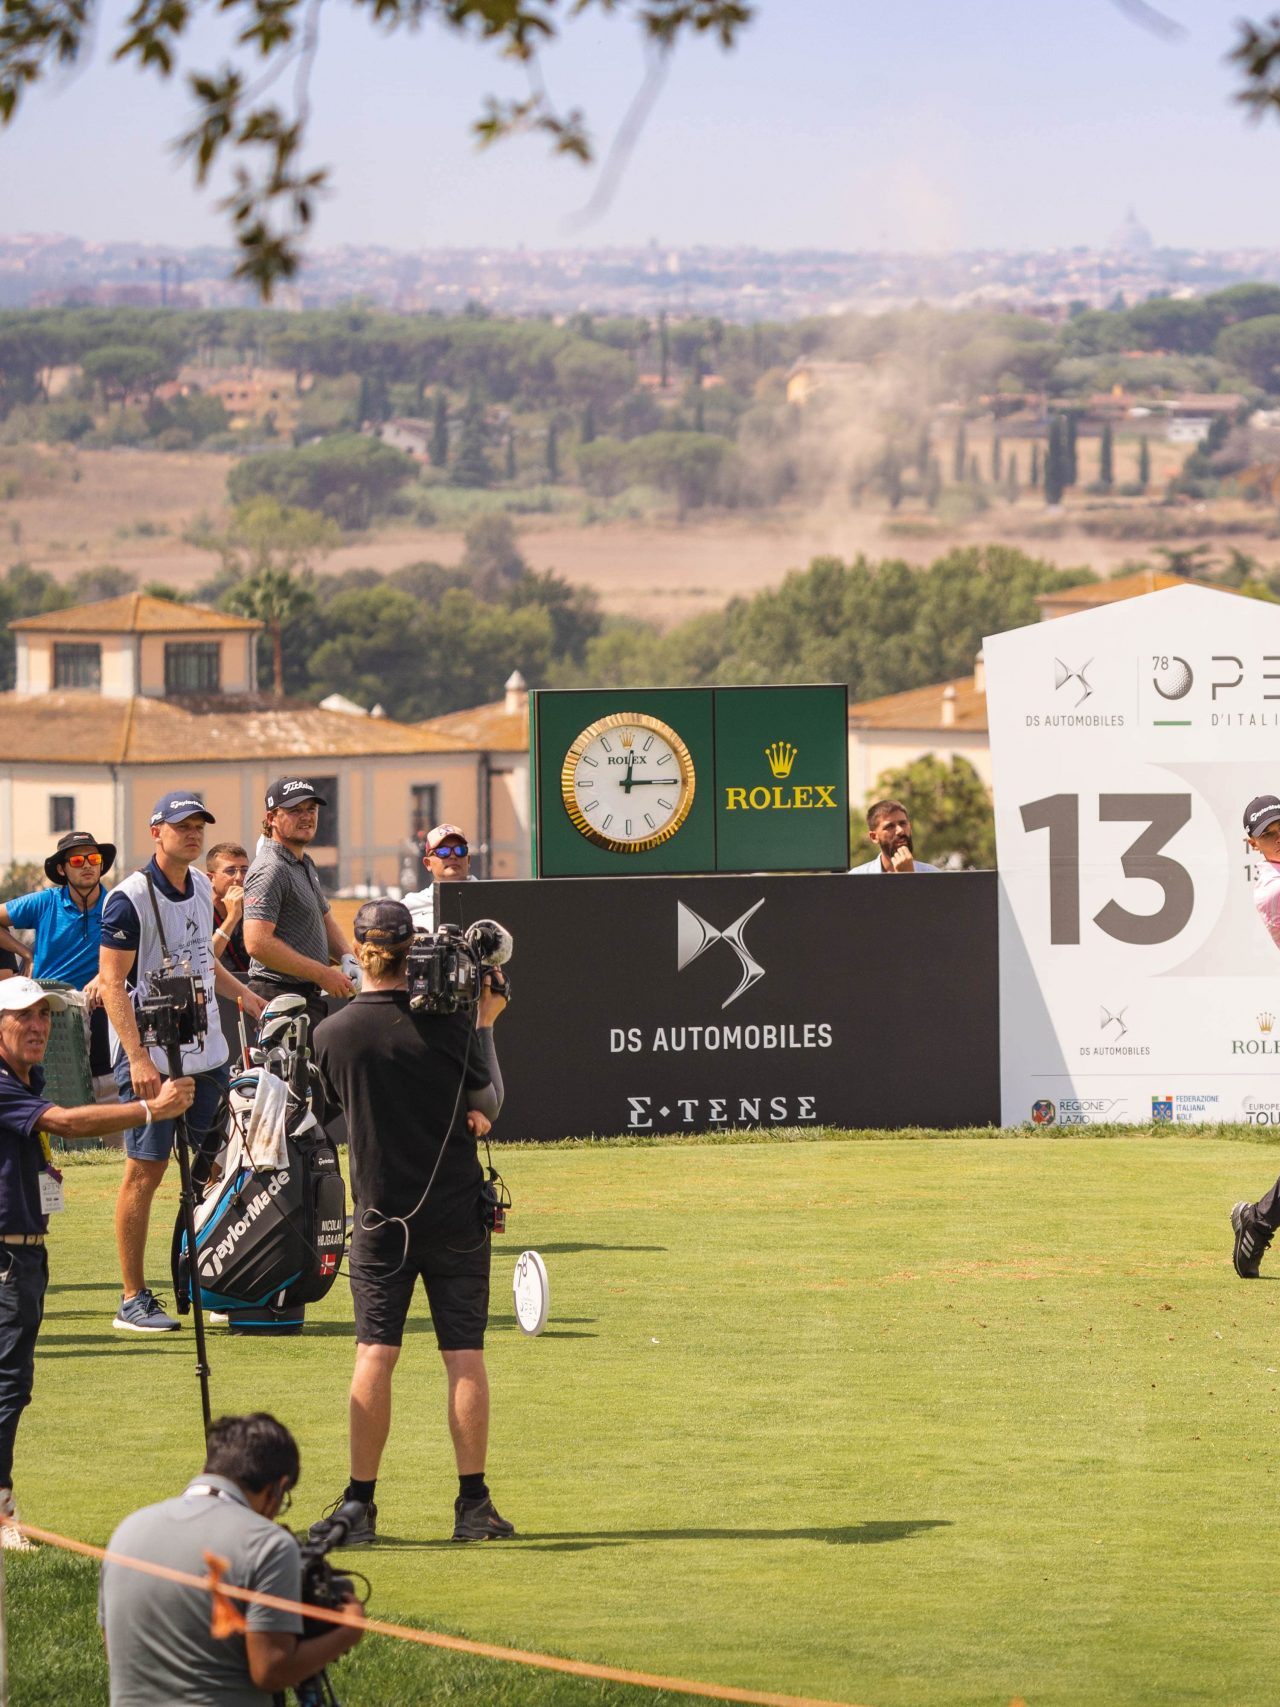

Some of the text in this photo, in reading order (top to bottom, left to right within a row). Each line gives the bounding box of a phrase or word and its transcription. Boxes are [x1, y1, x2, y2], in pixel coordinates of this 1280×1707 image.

[1152, 656, 1170, 671] 78
[1026, 715, 1124, 727] DS AUTOMOBILES
[608, 756, 647, 765] ROLEX
[726, 786, 837, 810] ROLEX
[1019, 793, 1195, 945] 13
[610, 1023, 833, 1053] DS AUTOMOBILES
[1080, 1046, 1151, 1056] DS AUTOMOBILES
[1176, 1095, 1219, 1103] FEDERAZIONE
[1060, 1101, 1104, 1111] REGIONE
[1176, 1104, 1206, 1112] ITALIANA
[1060, 1115, 1090, 1124] LAZIO
[197, 1170, 290, 1277] TaylorMade
[517, 1253, 527, 1287] 78
